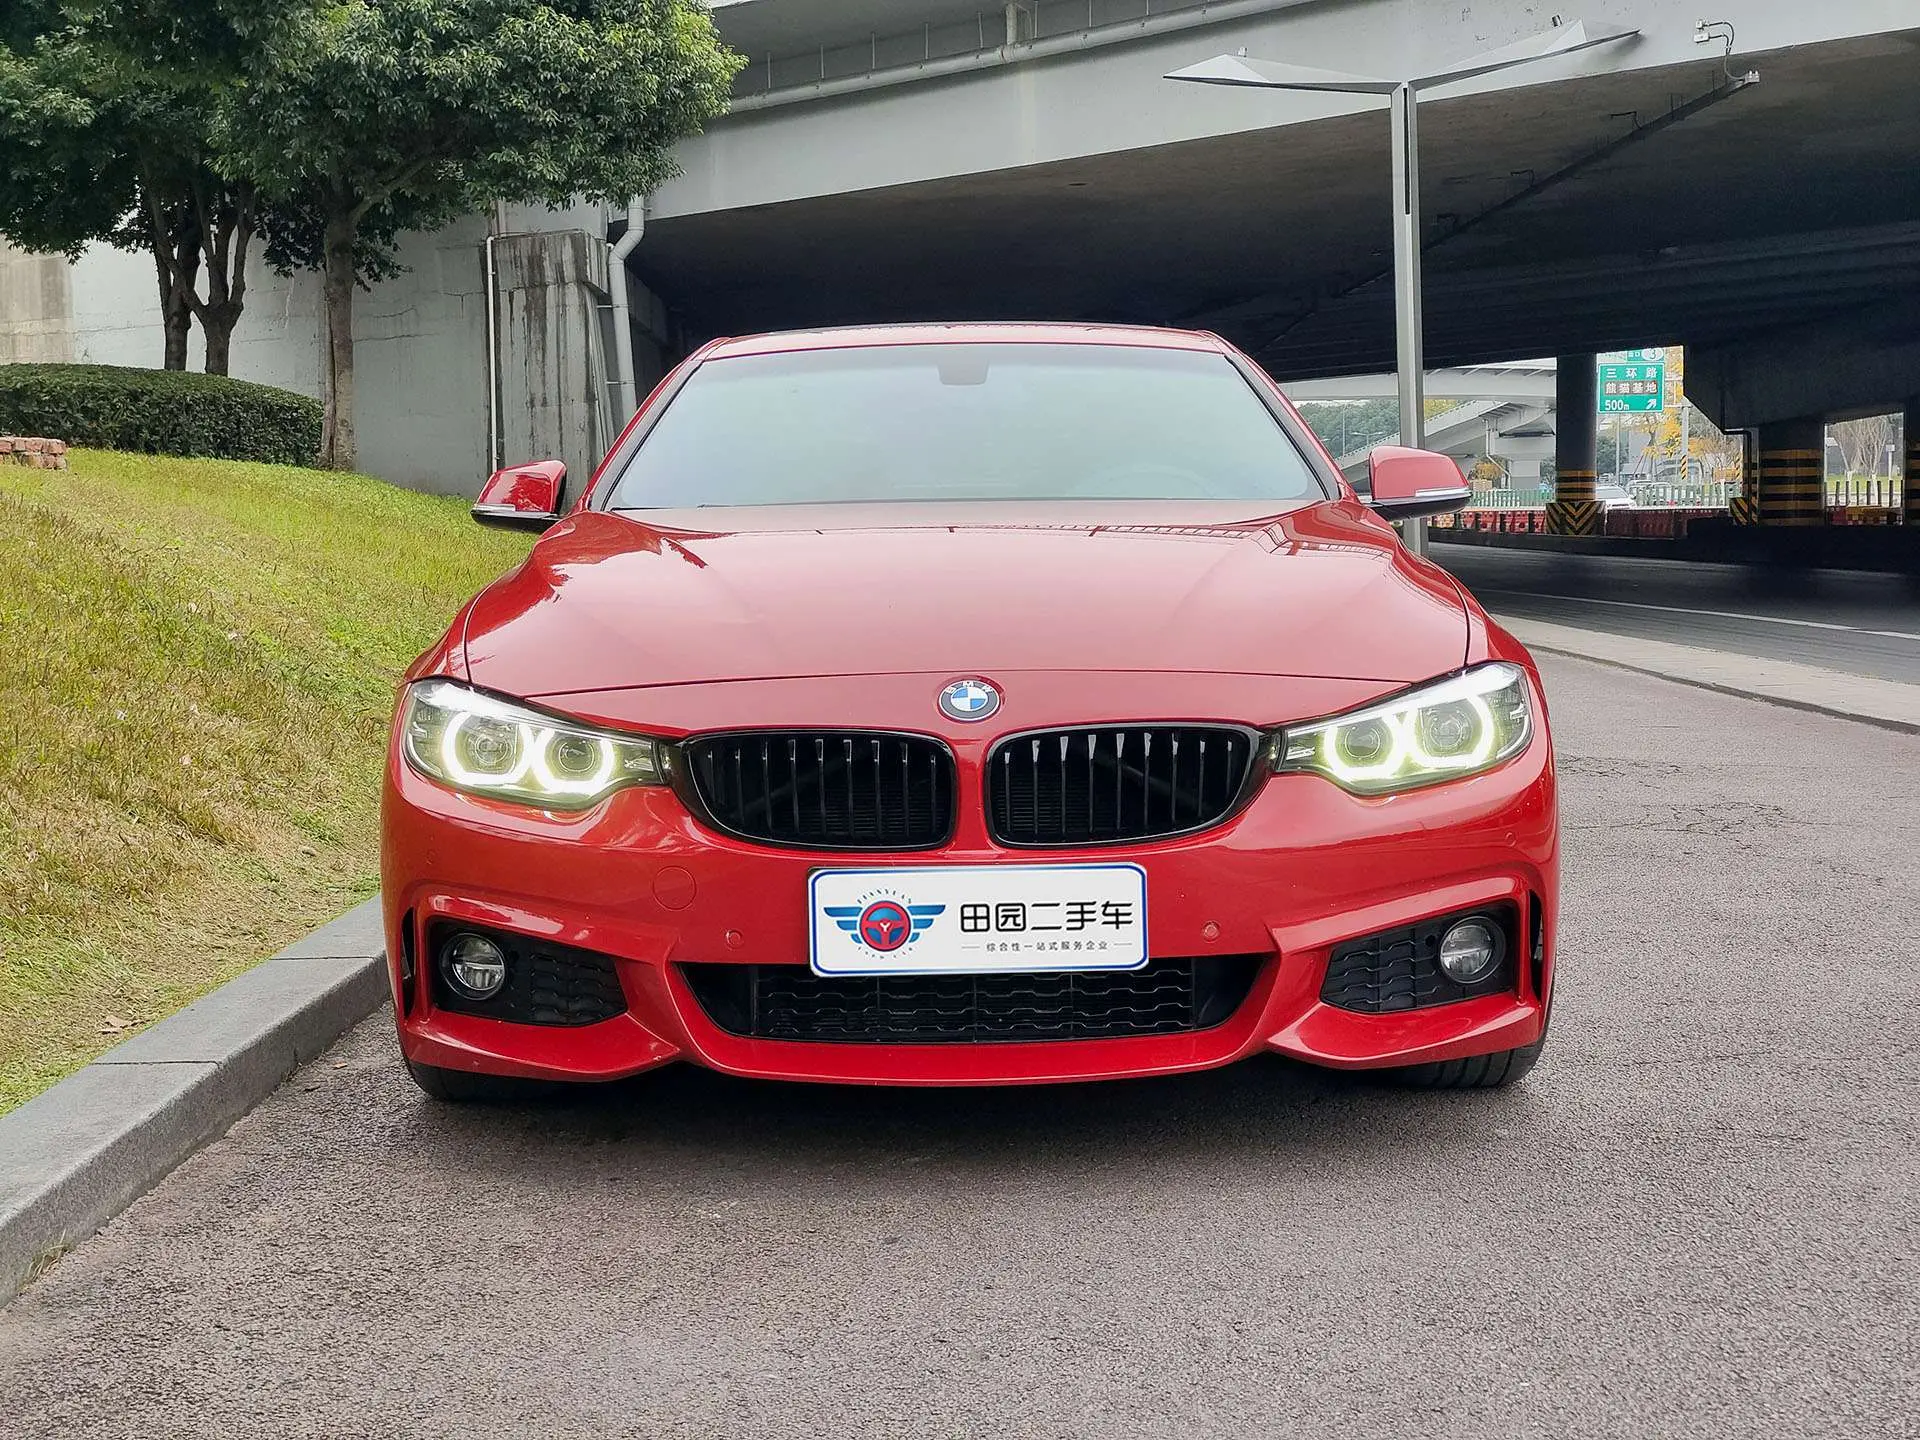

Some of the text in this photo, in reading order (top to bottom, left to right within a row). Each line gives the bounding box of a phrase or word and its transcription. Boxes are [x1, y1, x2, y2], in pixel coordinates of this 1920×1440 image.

[1606, 367, 1657, 379] 三环路
[1605, 381, 1657, 394] 熊猫基地
[1605, 400, 1630, 411] 500m
[960, 901, 1133, 932] 田园二手车
[986, 940, 1108, 952] 综合性一站式服务企业
